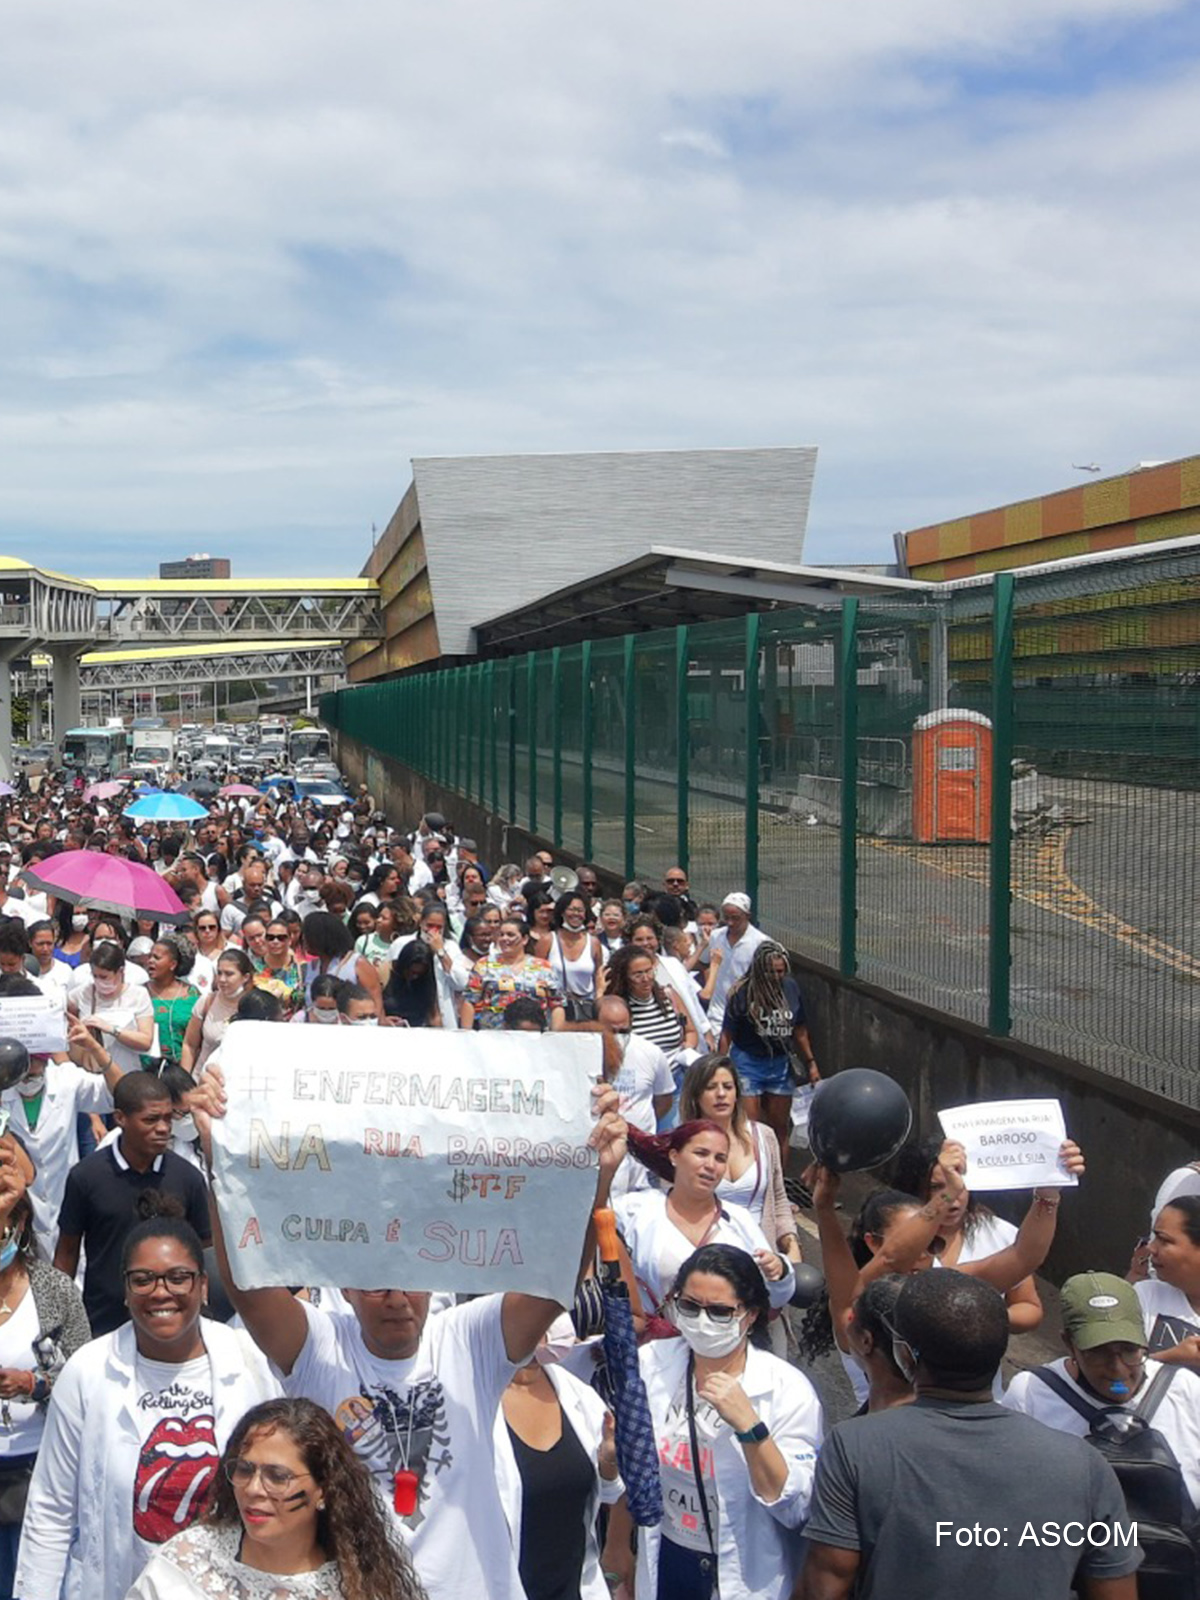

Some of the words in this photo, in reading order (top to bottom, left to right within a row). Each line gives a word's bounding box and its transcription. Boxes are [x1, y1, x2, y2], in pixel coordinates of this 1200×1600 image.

[293, 1068, 545, 1115] ENFERMAGEM
[248, 1118, 333, 1171] NA
[364, 1128, 424, 1158] RUA
[447, 1135, 592, 1169] BARROSO
[980, 1132, 1037, 1146] BARROSO
[977, 1158, 983, 1166] A
[985, 1155, 1016, 1166] CULPA
[1025, 1153, 1046, 1163] SUA
[238, 1217, 263, 1248] A
[281, 1214, 369, 1243] CULPA
[386, 1220, 400, 1242] É
[418, 1221, 524, 1266] SUA
[160, 1383, 192, 1396] the
